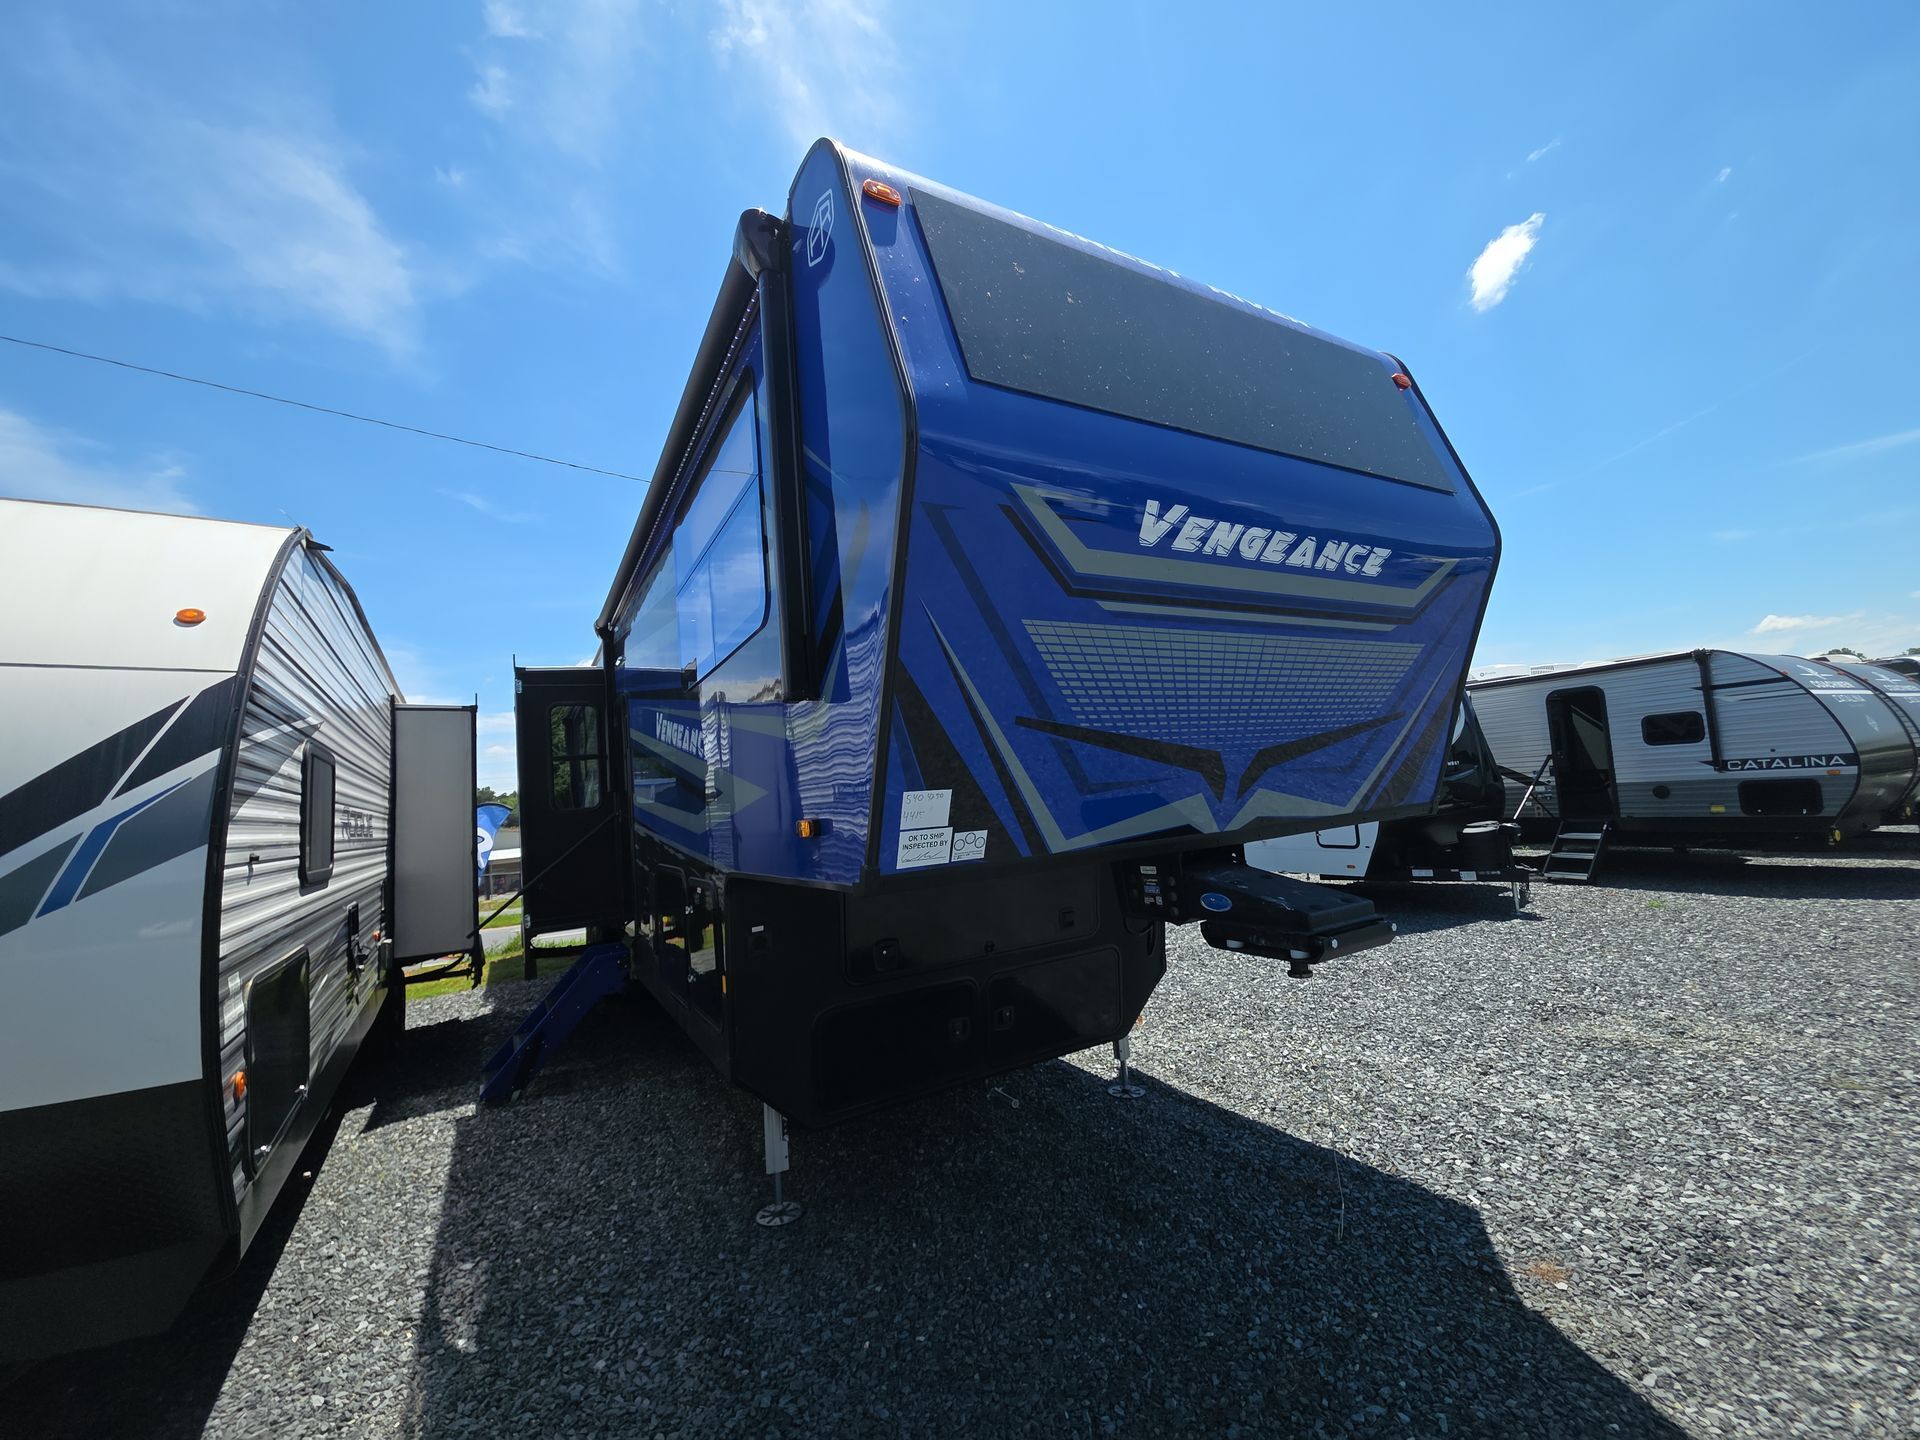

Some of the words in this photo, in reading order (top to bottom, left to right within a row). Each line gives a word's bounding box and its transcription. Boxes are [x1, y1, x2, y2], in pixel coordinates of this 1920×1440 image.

[1138, 499, 1392, 578] VENGEANCE
[656, 711, 705, 759] VENGEANC
[1727, 755, 1846, 771] CATALINA
[902, 841, 938, 849] INSPECTED
